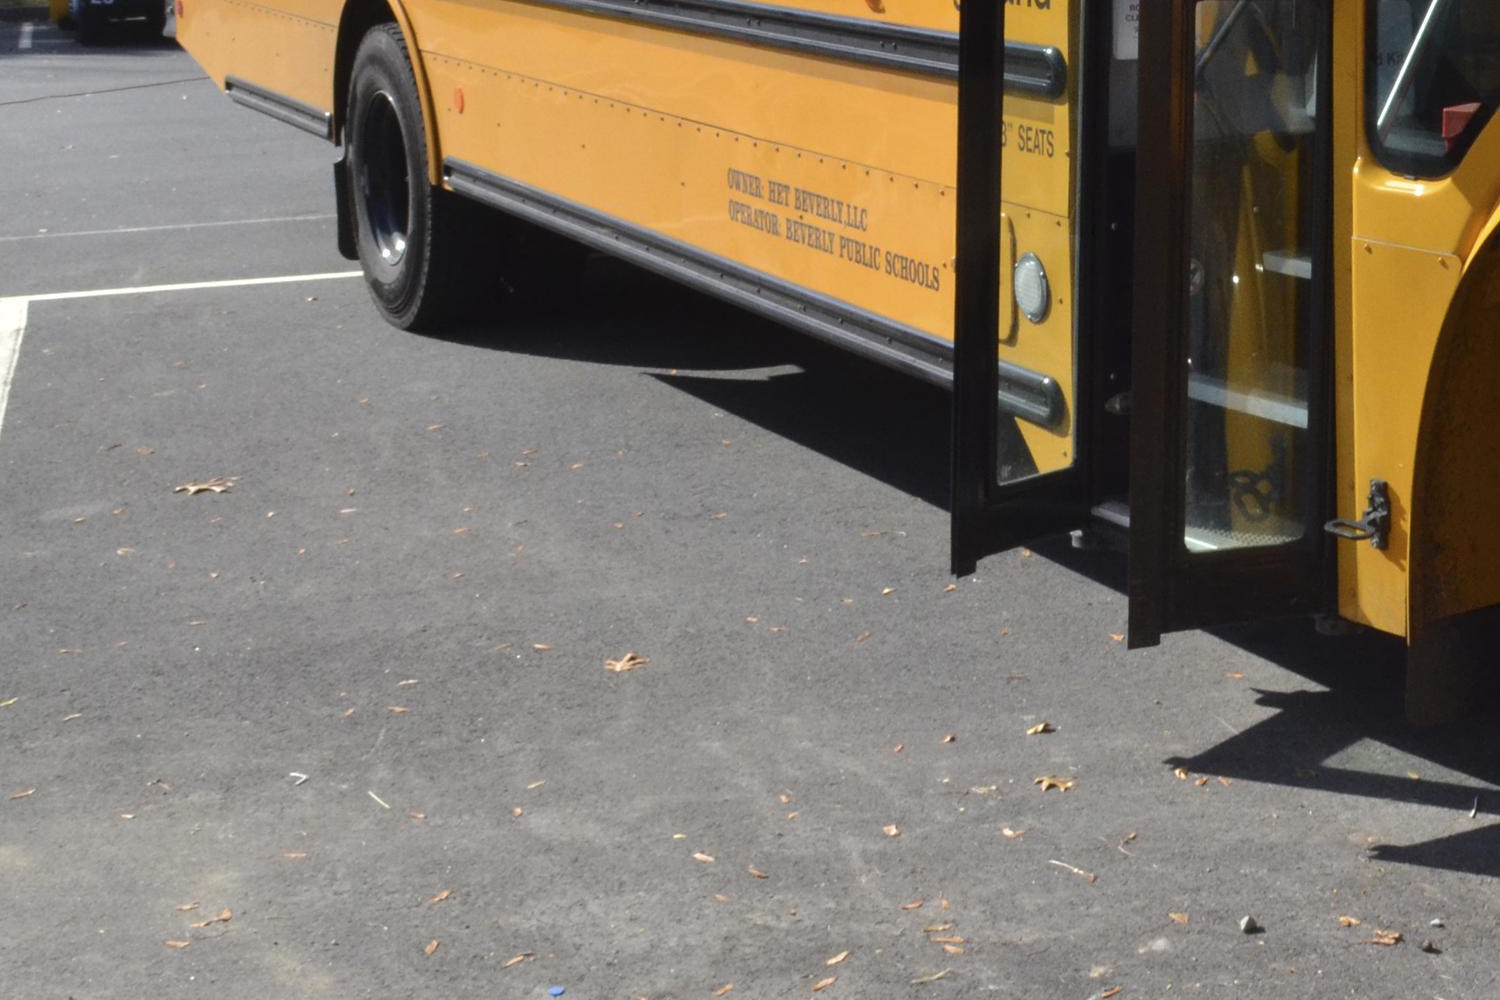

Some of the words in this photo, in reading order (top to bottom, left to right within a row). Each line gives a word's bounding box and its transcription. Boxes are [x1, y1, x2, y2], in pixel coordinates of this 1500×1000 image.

[1017, 123, 1055, 158] SEATS
[727, 167, 764, 199] OWNER:
[768, 180, 791, 207] HET
[728, 199, 781, 237] OPERATOR:
[785, 217, 835, 255] BEVERLY
[839, 235, 881, 271] PUBLIC
[884, 251, 940, 292] SCHOOLS
